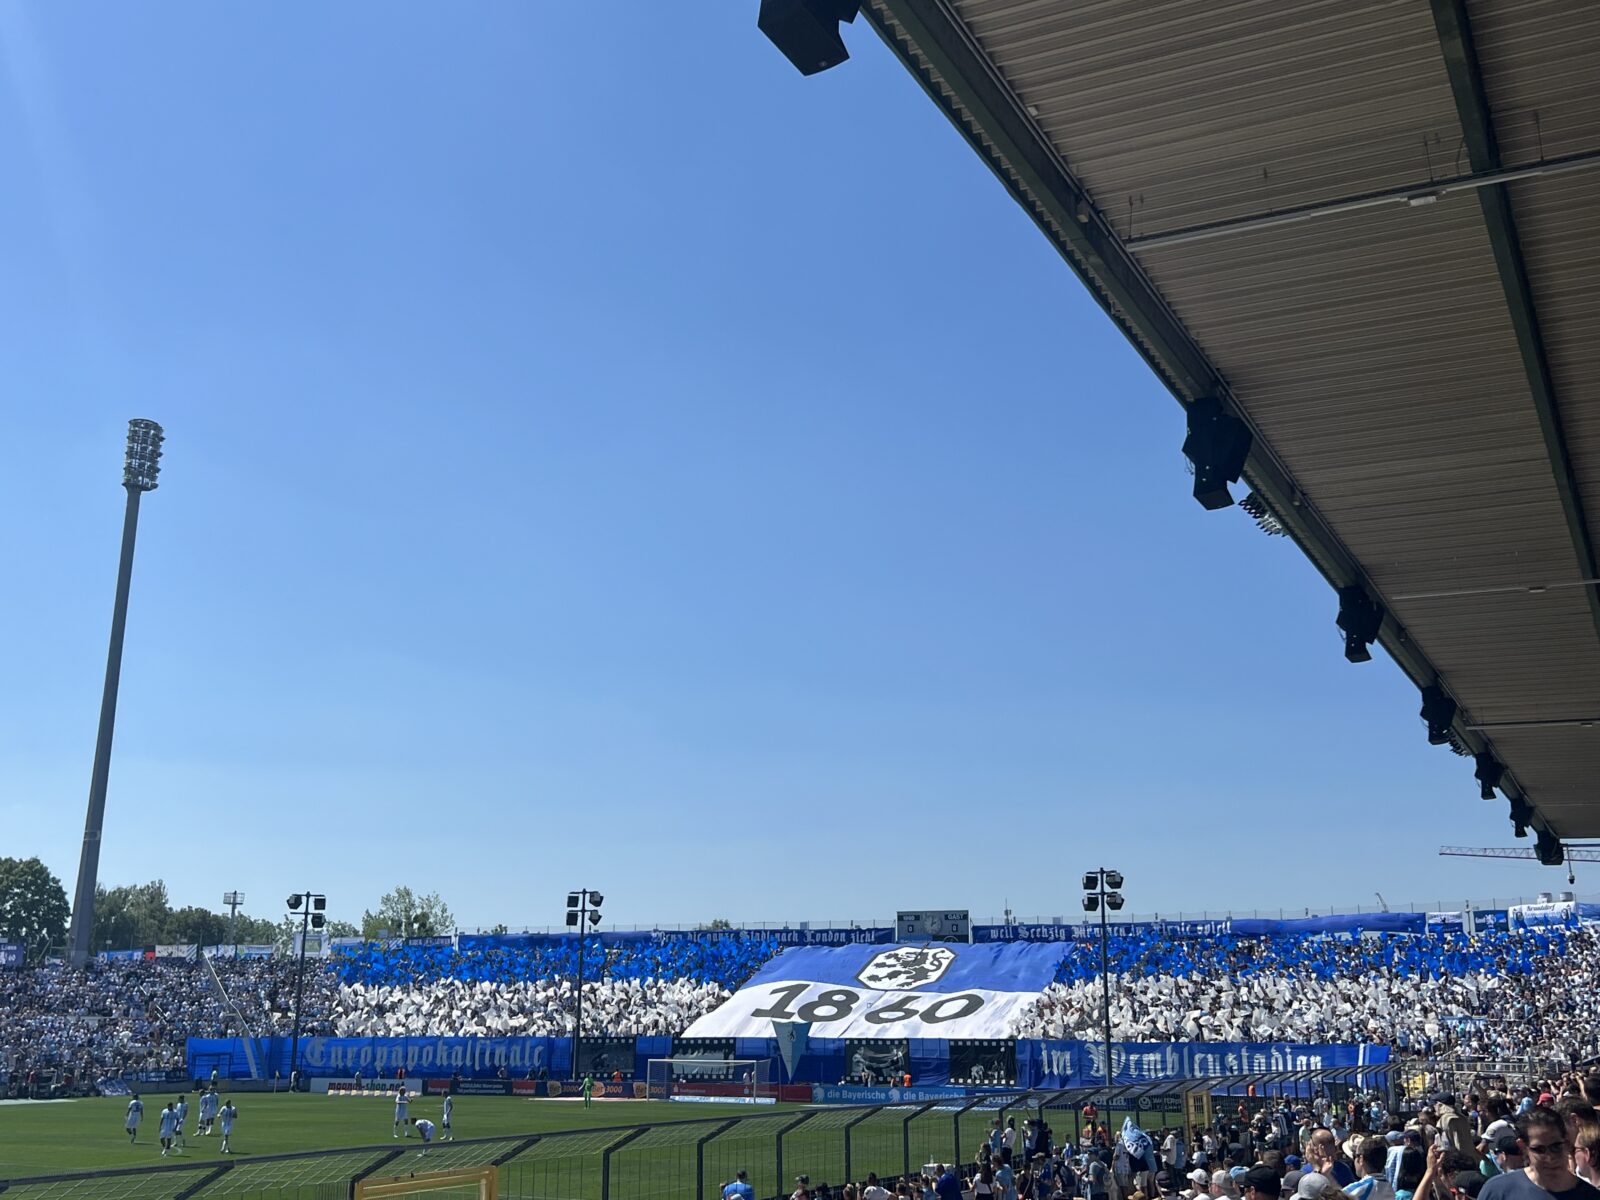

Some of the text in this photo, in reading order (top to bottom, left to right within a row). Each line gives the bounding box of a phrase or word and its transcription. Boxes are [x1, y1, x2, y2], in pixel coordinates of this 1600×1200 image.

[803, 930, 846, 944] London
[990, 926, 1014, 939] weil
[1018, 925, 1066, 941] Sechzig
[1071, 925, 1126, 940] Münhen
[751, 983, 985, 1024] 1860
[304, 1038, 544, 1071] Europapokalfinale
[1040, 1042, 1074, 1076] im
[827, 1089, 886, 1100] die Bayerische
[903, 1092, 916, 1100] die
